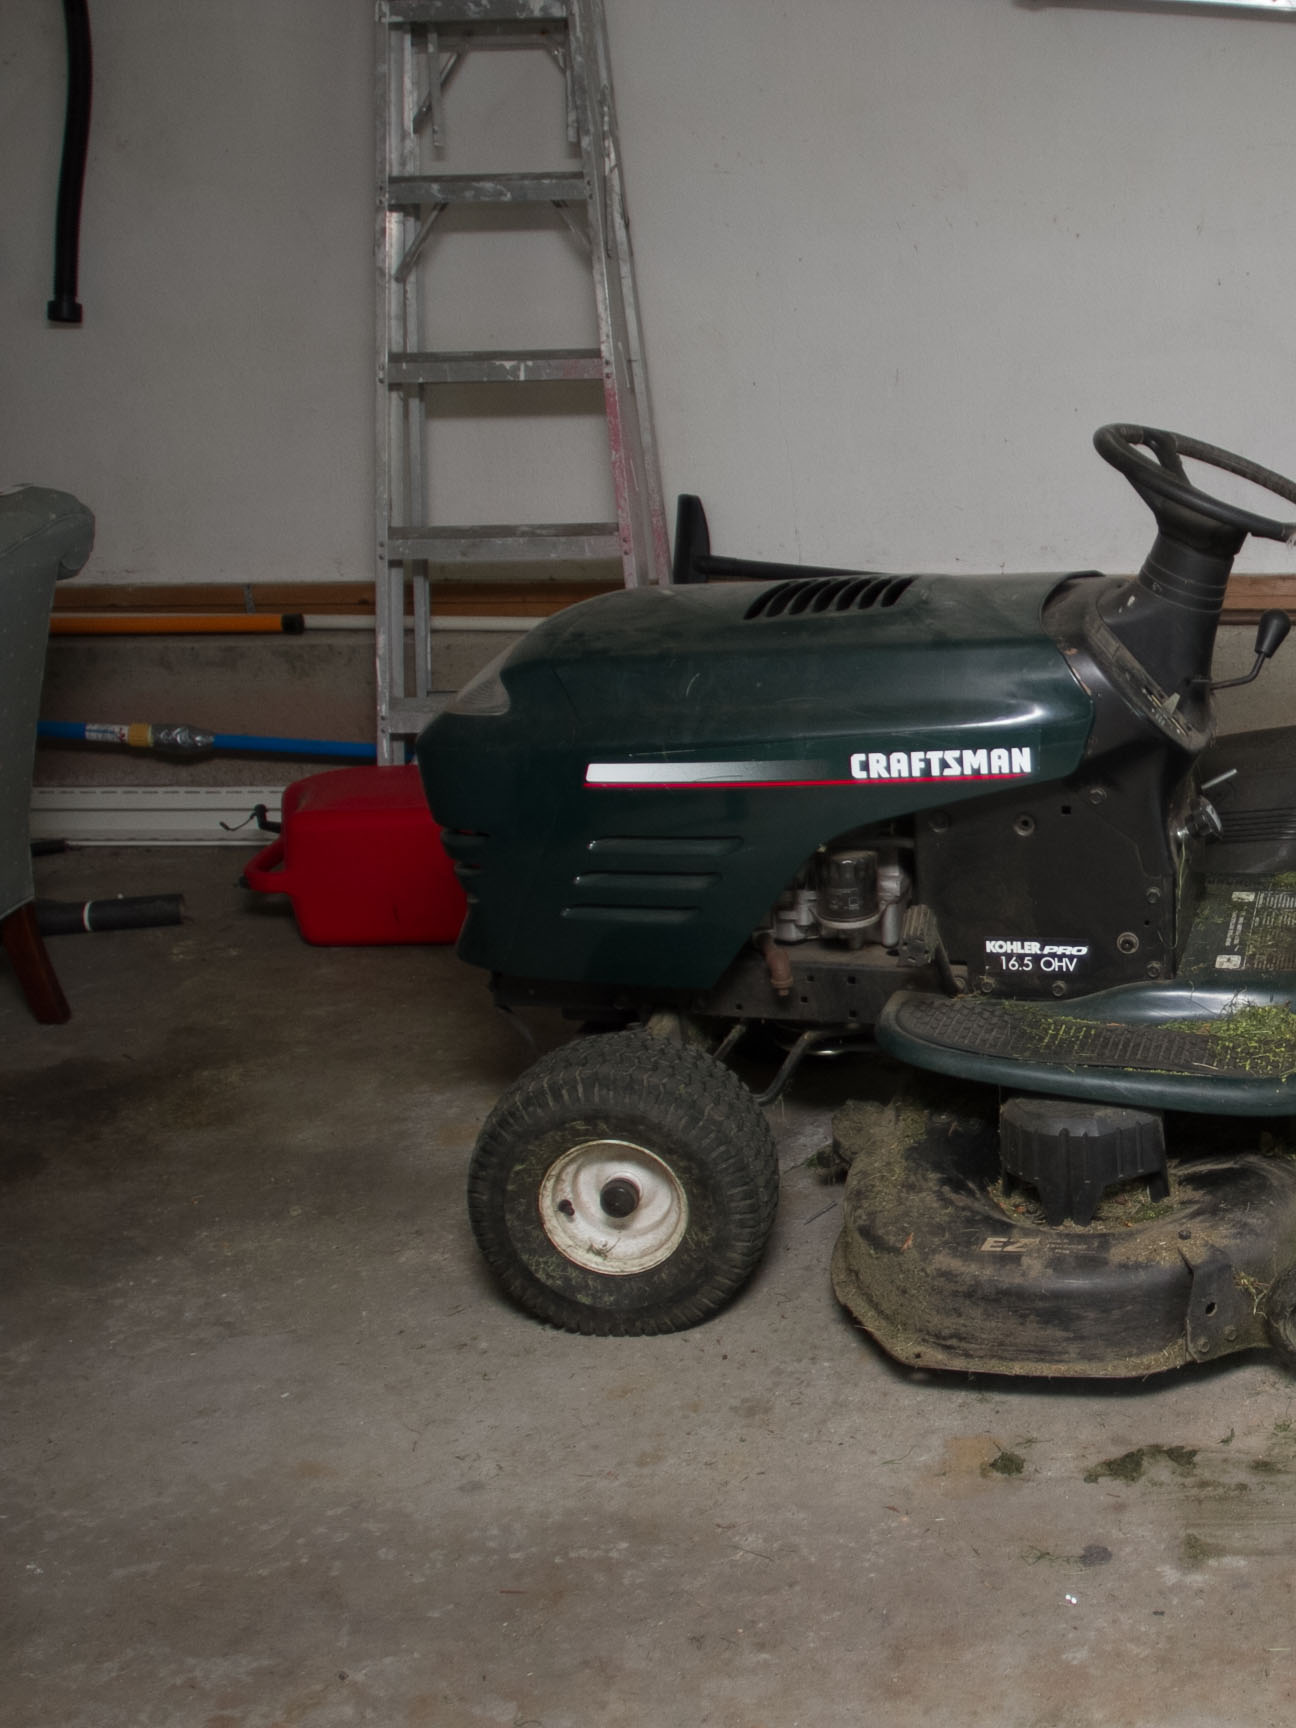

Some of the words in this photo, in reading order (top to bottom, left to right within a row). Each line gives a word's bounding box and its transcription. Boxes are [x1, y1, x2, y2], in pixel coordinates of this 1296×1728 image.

[850, 747, 1032, 779] CRAFTSMAN
[985, 940, 1042, 954] KOHLER
[1042, 945, 1089, 956] PRO
[1000, 956, 1033, 971] 16.5
[1040, 956, 1078, 972] OHV
